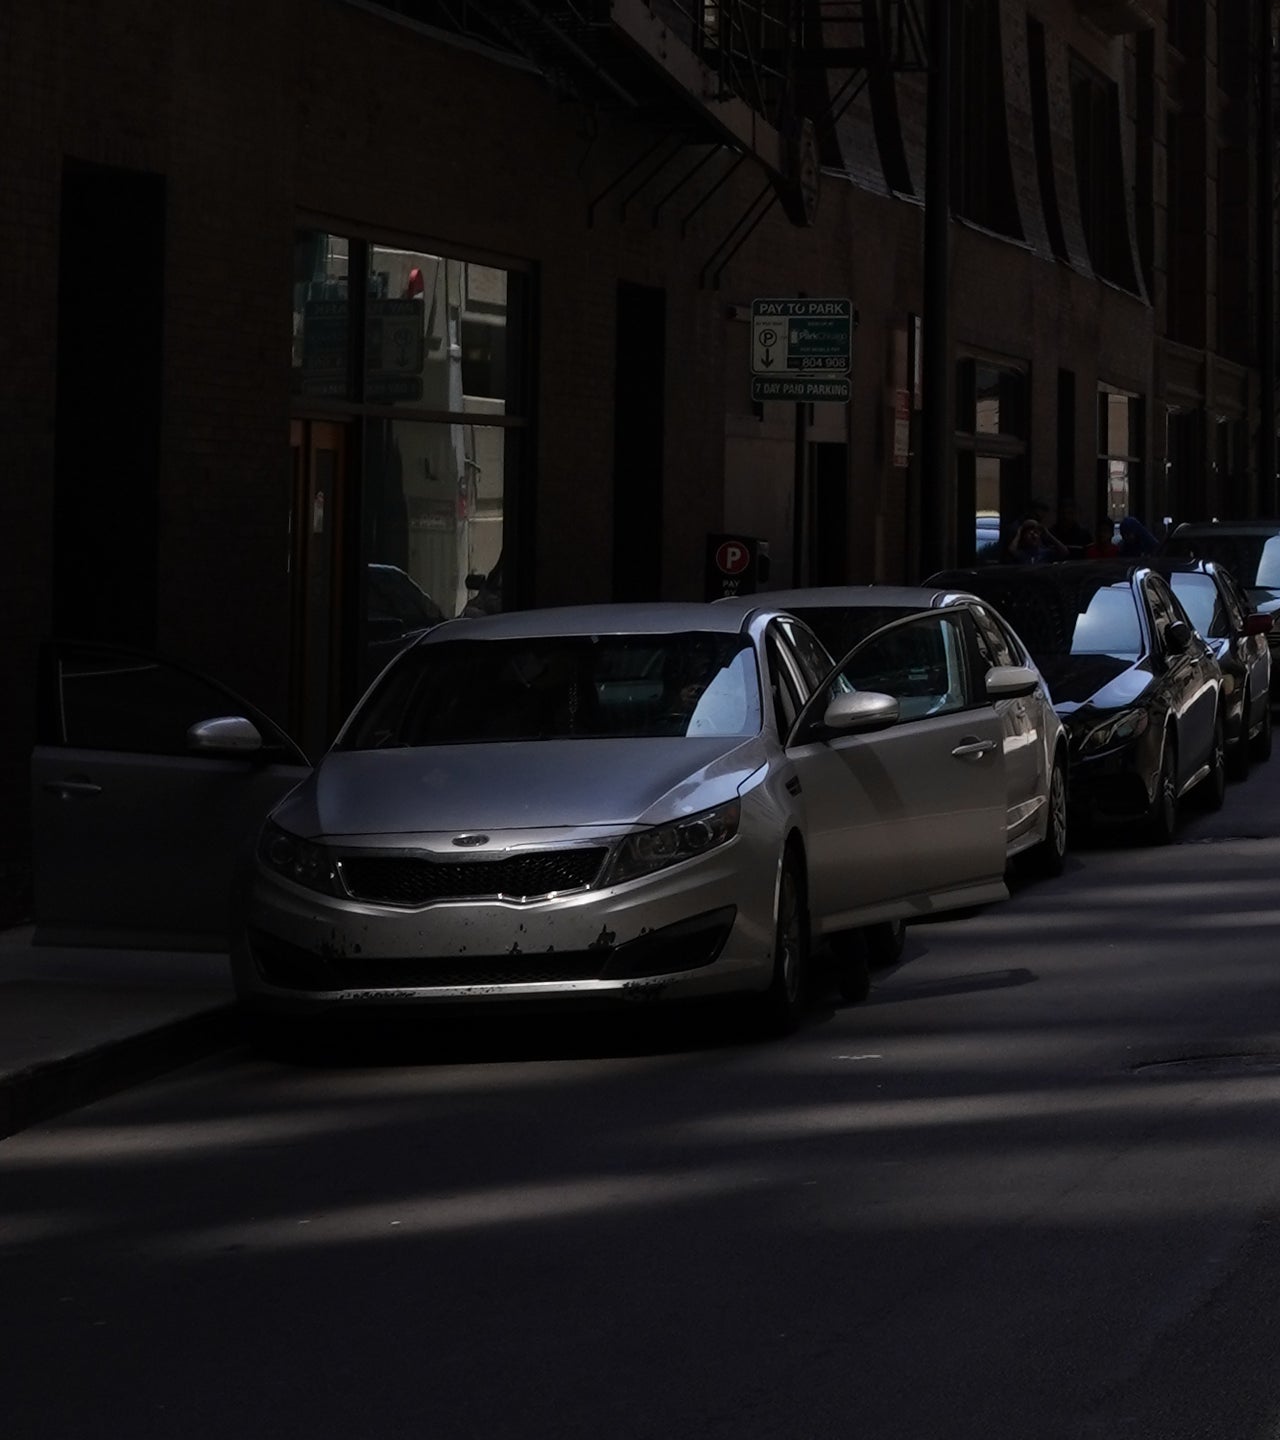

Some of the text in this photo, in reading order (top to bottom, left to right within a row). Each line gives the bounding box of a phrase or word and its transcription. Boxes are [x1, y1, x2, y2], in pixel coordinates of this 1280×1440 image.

[759, 303, 844, 315] PAY TO PARK
[802, 358, 823, 368] 804
[825, 358, 847, 368] 908
[755, 384, 848, 396] 7 DAY PAID PARKING
